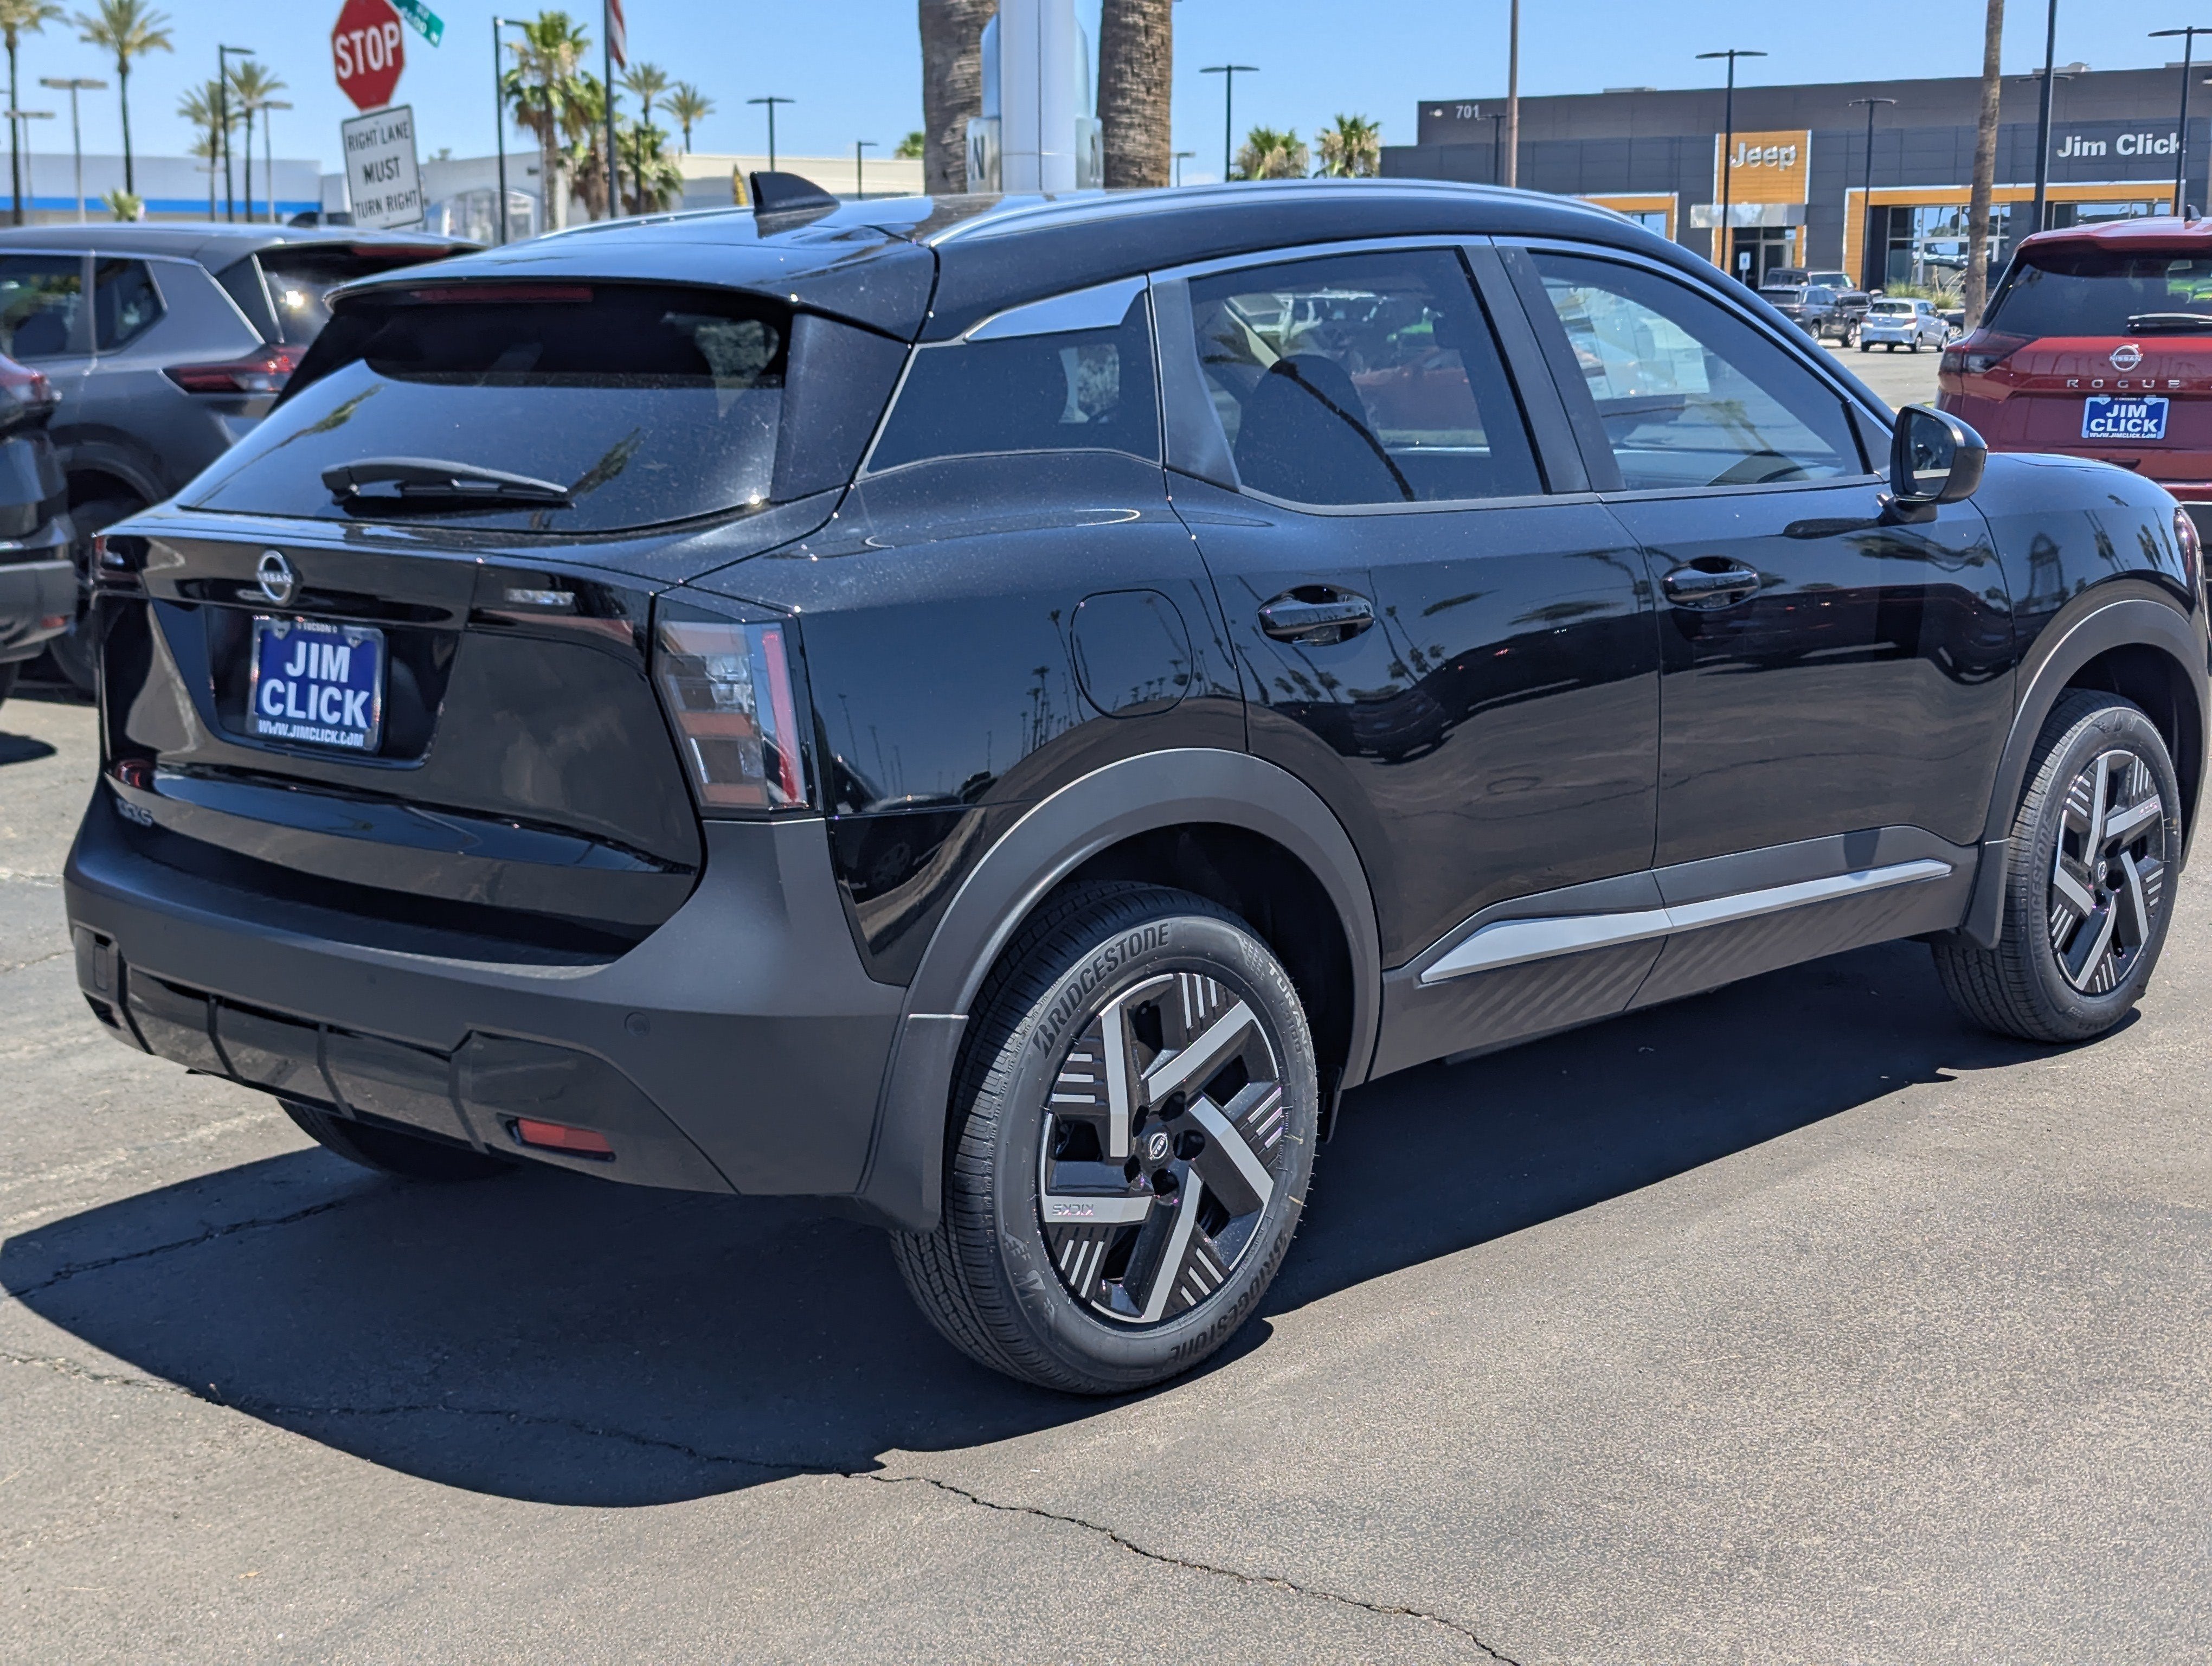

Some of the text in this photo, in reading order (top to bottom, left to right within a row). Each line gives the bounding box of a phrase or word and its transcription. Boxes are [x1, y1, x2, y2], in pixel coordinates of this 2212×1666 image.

[334, 21, 400, 79] STOP
[1456, 104, 1479, 119] 701
[348, 122, 409, 152] RIGHT LANE
[2057, 132, 2187, 157] Jim Click
[363, 156, 400, 185] MUST
[1729, 142, 1796, 171] Jeep
[356, 190, 417, 218] TURN RIGHT
[2066, 379, 2180, 388] ROGUE
[2090, 419, 2158, 432] CLICK
[2106, 405, 2147, 418] JIM
[303, 622, 332, 633] TUCSON
[285, 640, 351, 683] JIM
[262, 678, 370, 729] CLICK
[1032, 922, 1169, 1059] BRIDGESTONE
[1052, 1204, 1094, 1215] KICKS
